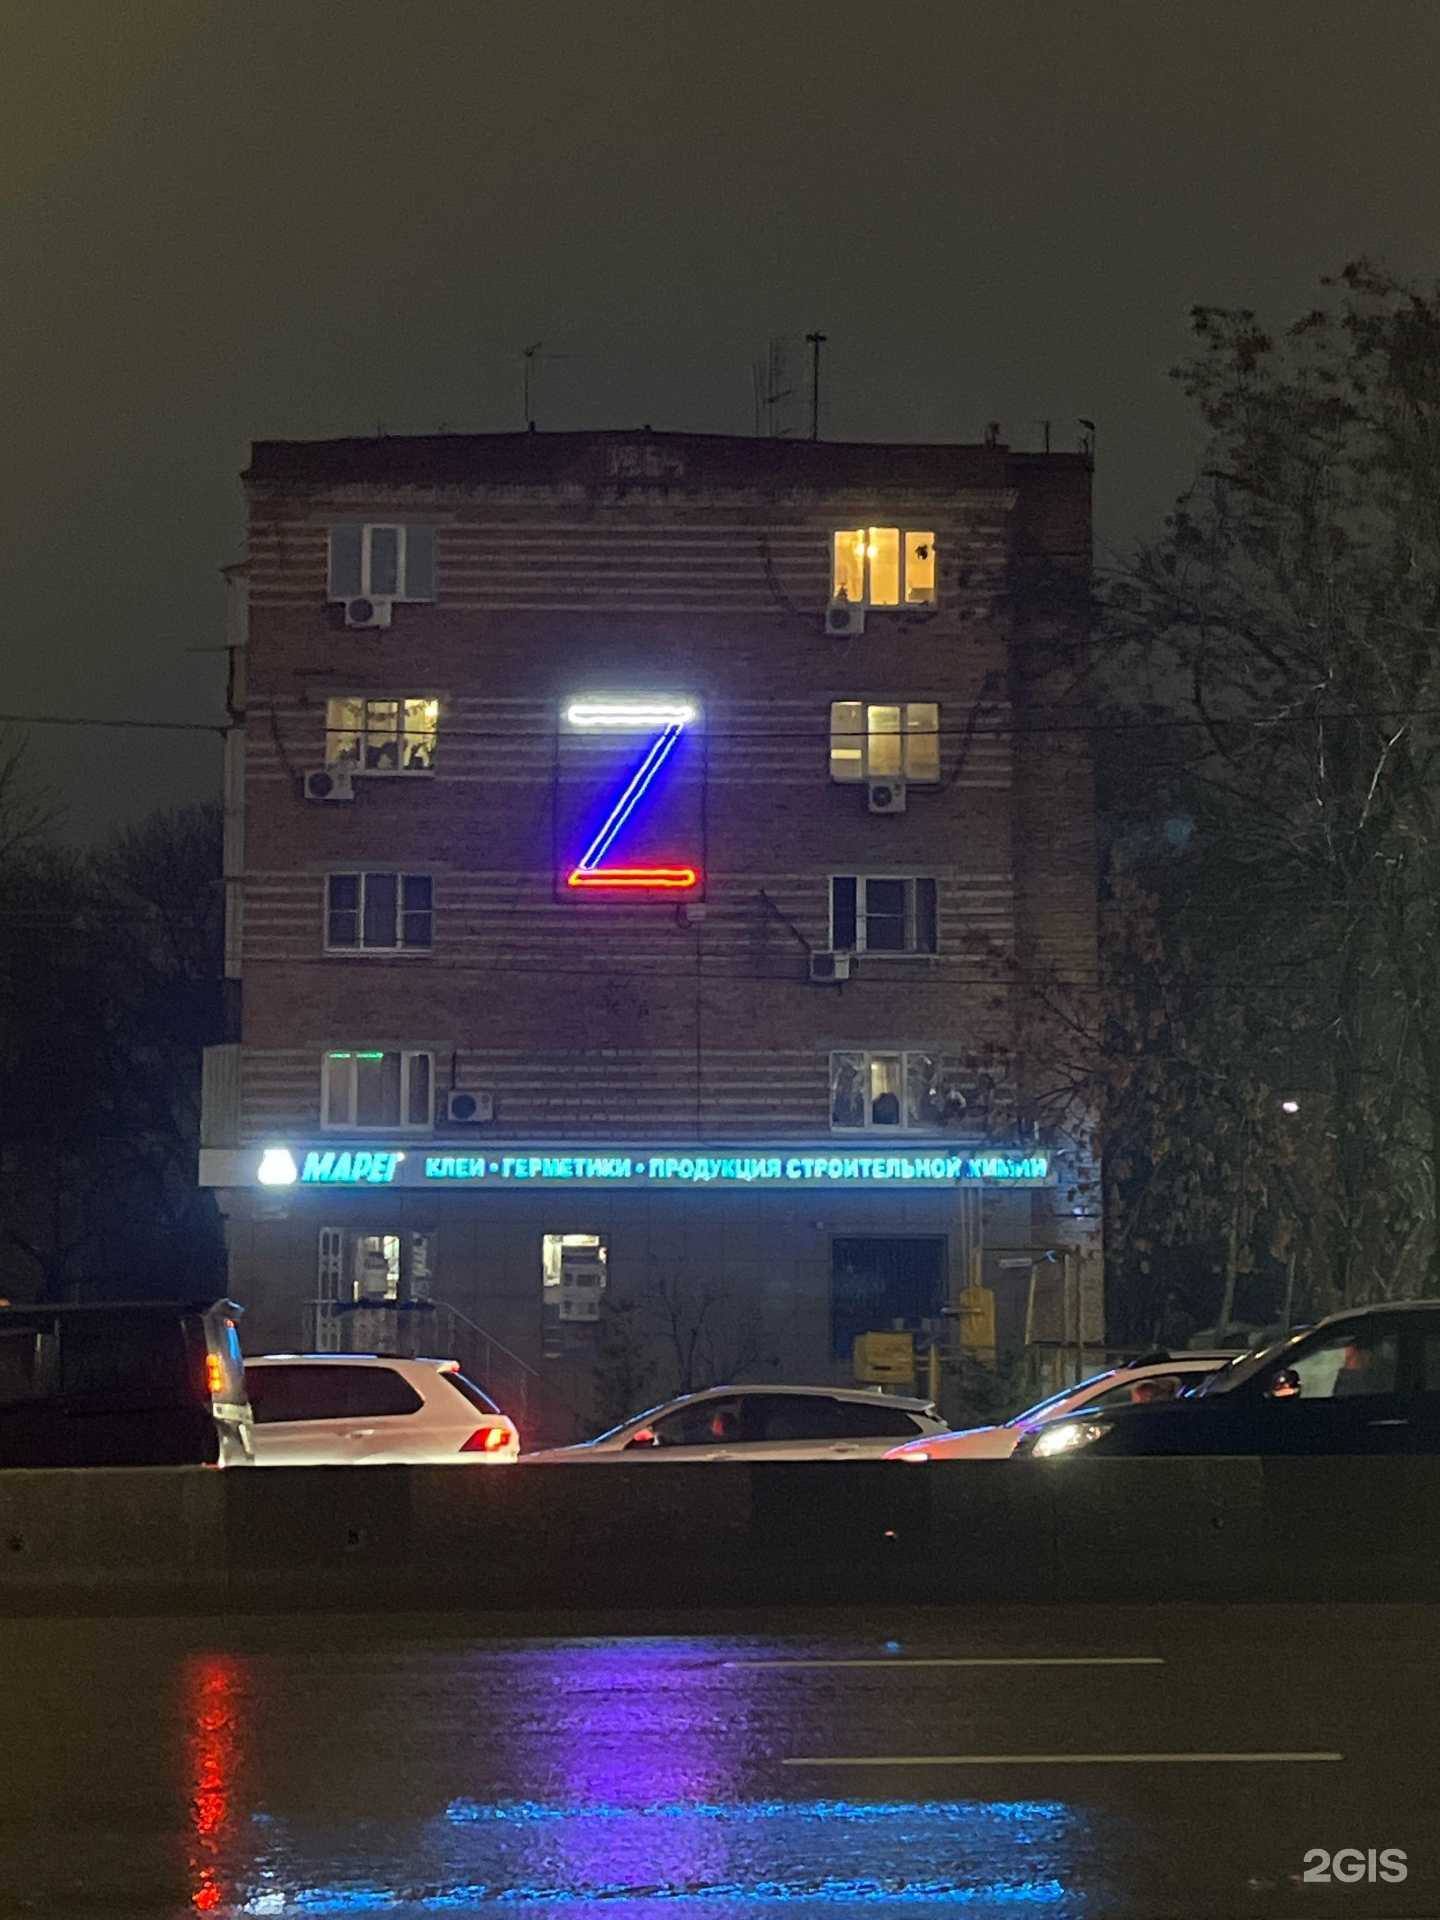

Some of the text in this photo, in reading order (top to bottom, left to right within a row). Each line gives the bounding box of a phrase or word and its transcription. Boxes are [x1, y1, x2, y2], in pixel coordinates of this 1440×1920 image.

[567, 702, 697, 888] Z
[301, 1152, 402, 1183] MAPEI
[425, 1157, 485, 1179] КЛЕИ
[502, 1157, 631, 1179] ГЕРМЕТИКИ
[649, 1157, 781, 1182] ПРОДУКЦИЯ
[786, 1155, 961, 1179] СТРОИТЕЛЬНОЙ
